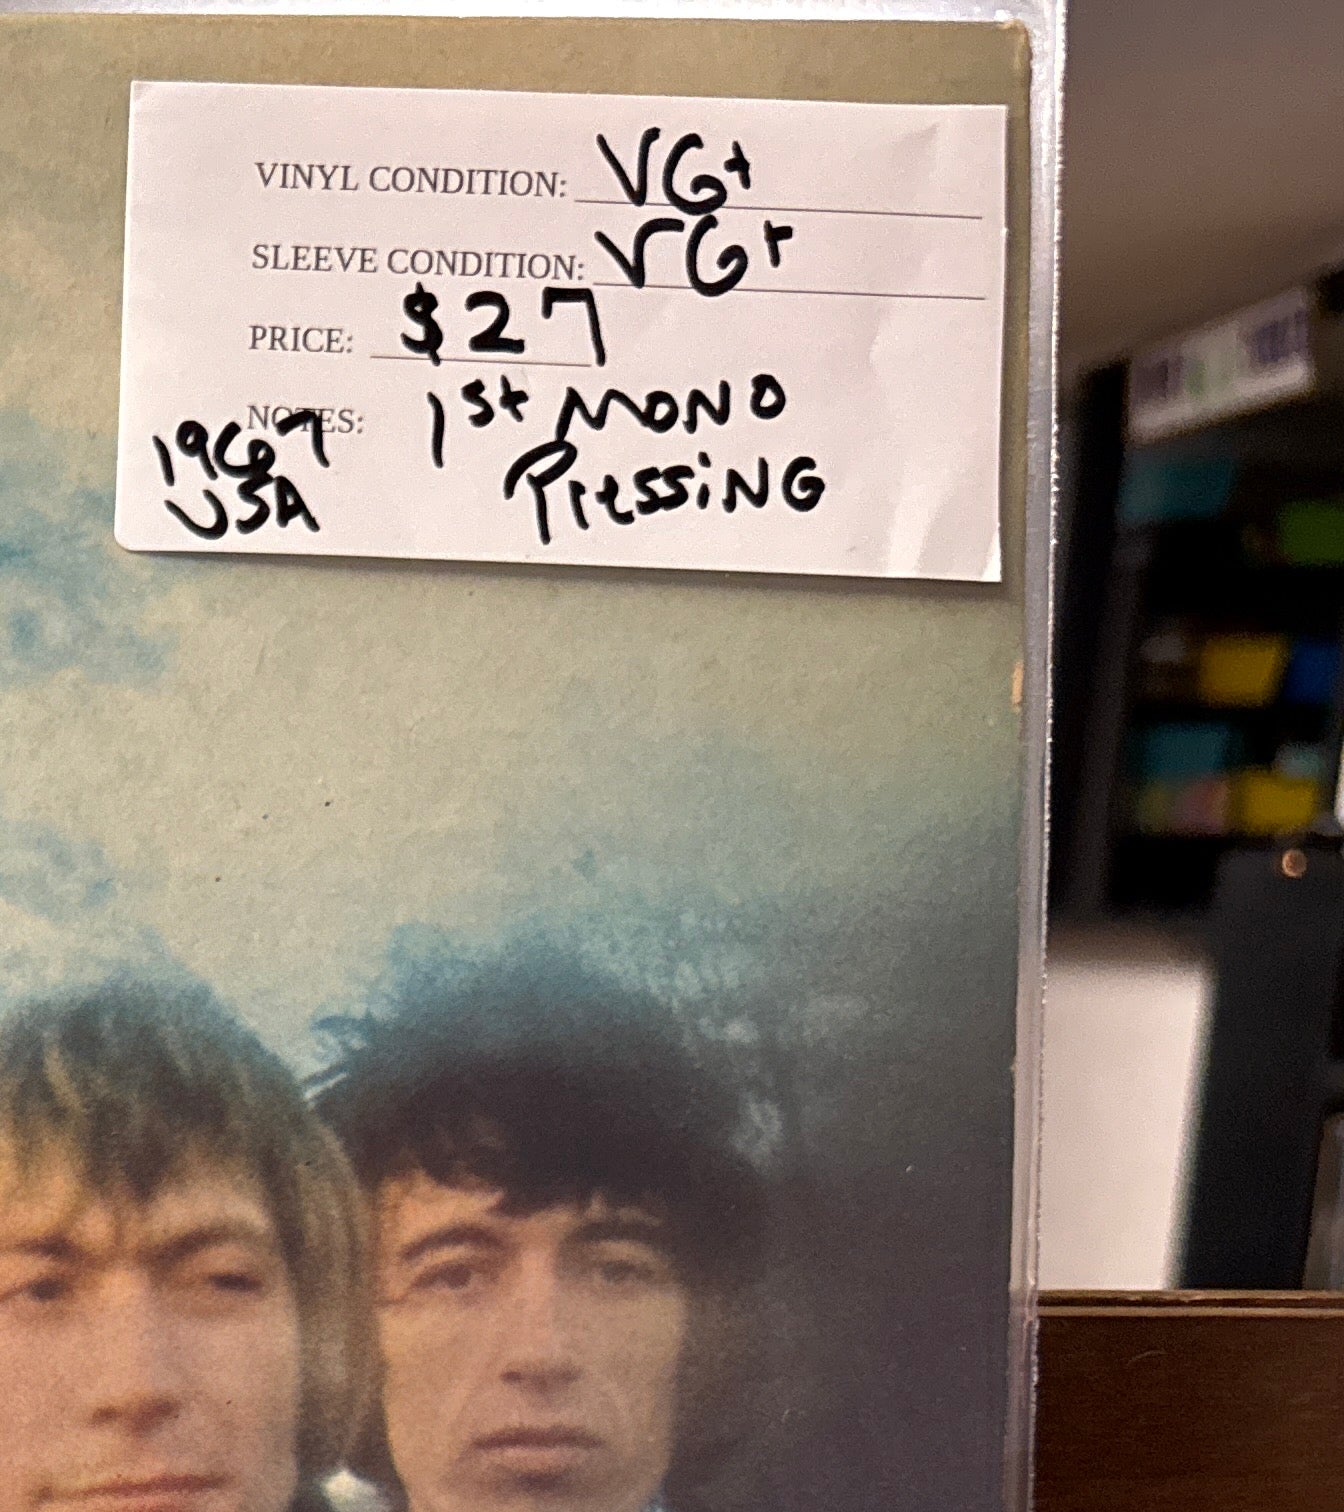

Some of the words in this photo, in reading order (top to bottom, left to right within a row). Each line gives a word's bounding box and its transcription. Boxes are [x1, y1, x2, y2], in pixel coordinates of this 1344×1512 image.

[254, 162, 359, 191] VINYL
[369, 165, 567, 198] CONDITION:
[596, 127, 752, 215] VG+
[252, 244, 378, 274] SLEEVE
[387, 249, 585, 281] CONDITION:
[593, 214, 793, 297] VG+
[247, 324, 354, 354] PRICE:
[400, 283, 606, 366] $27
[164, 474, 320, 541] USA
